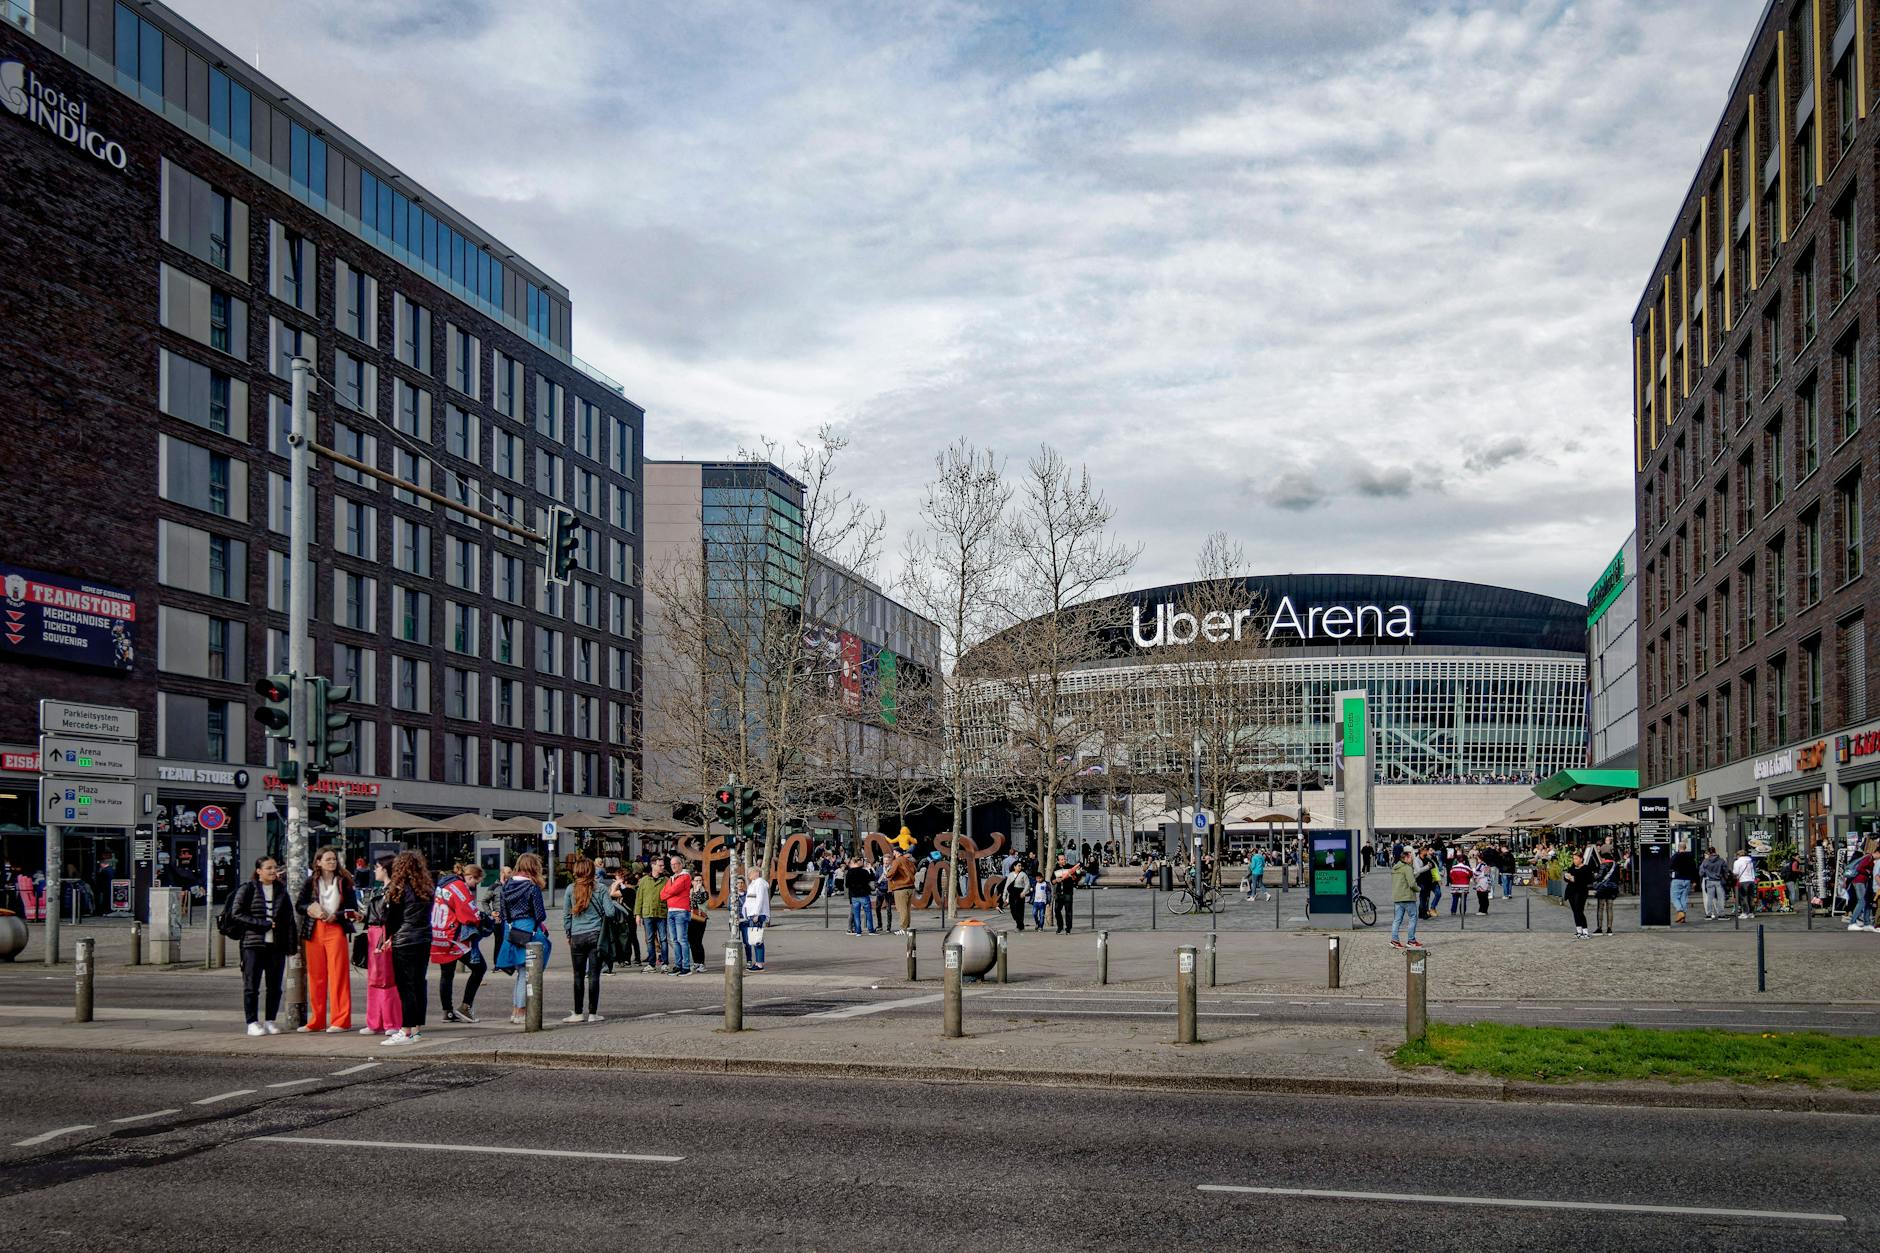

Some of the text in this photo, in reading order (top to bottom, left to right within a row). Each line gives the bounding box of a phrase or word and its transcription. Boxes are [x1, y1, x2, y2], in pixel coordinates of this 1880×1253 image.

[30, 71, 87, 124] hotel
[29, 95, 127, 169] INDIGO
[32, 585, 131, 619] TEAMSTORE
[43, 607, 111, 629] MERCHANDISE
[43, 620, 77, 634] TICKETS
[1132, 595, 1414, 648] Uber Arena
[42, 632, 88, 648] SOUVENIRS
[63, 708, 119, 722] Parkleitsystem
[79, 747, 102, 757] Arena
[158, 766, 236, 785] TEAM STORE
[78, 785, 99, 794] Plaza
